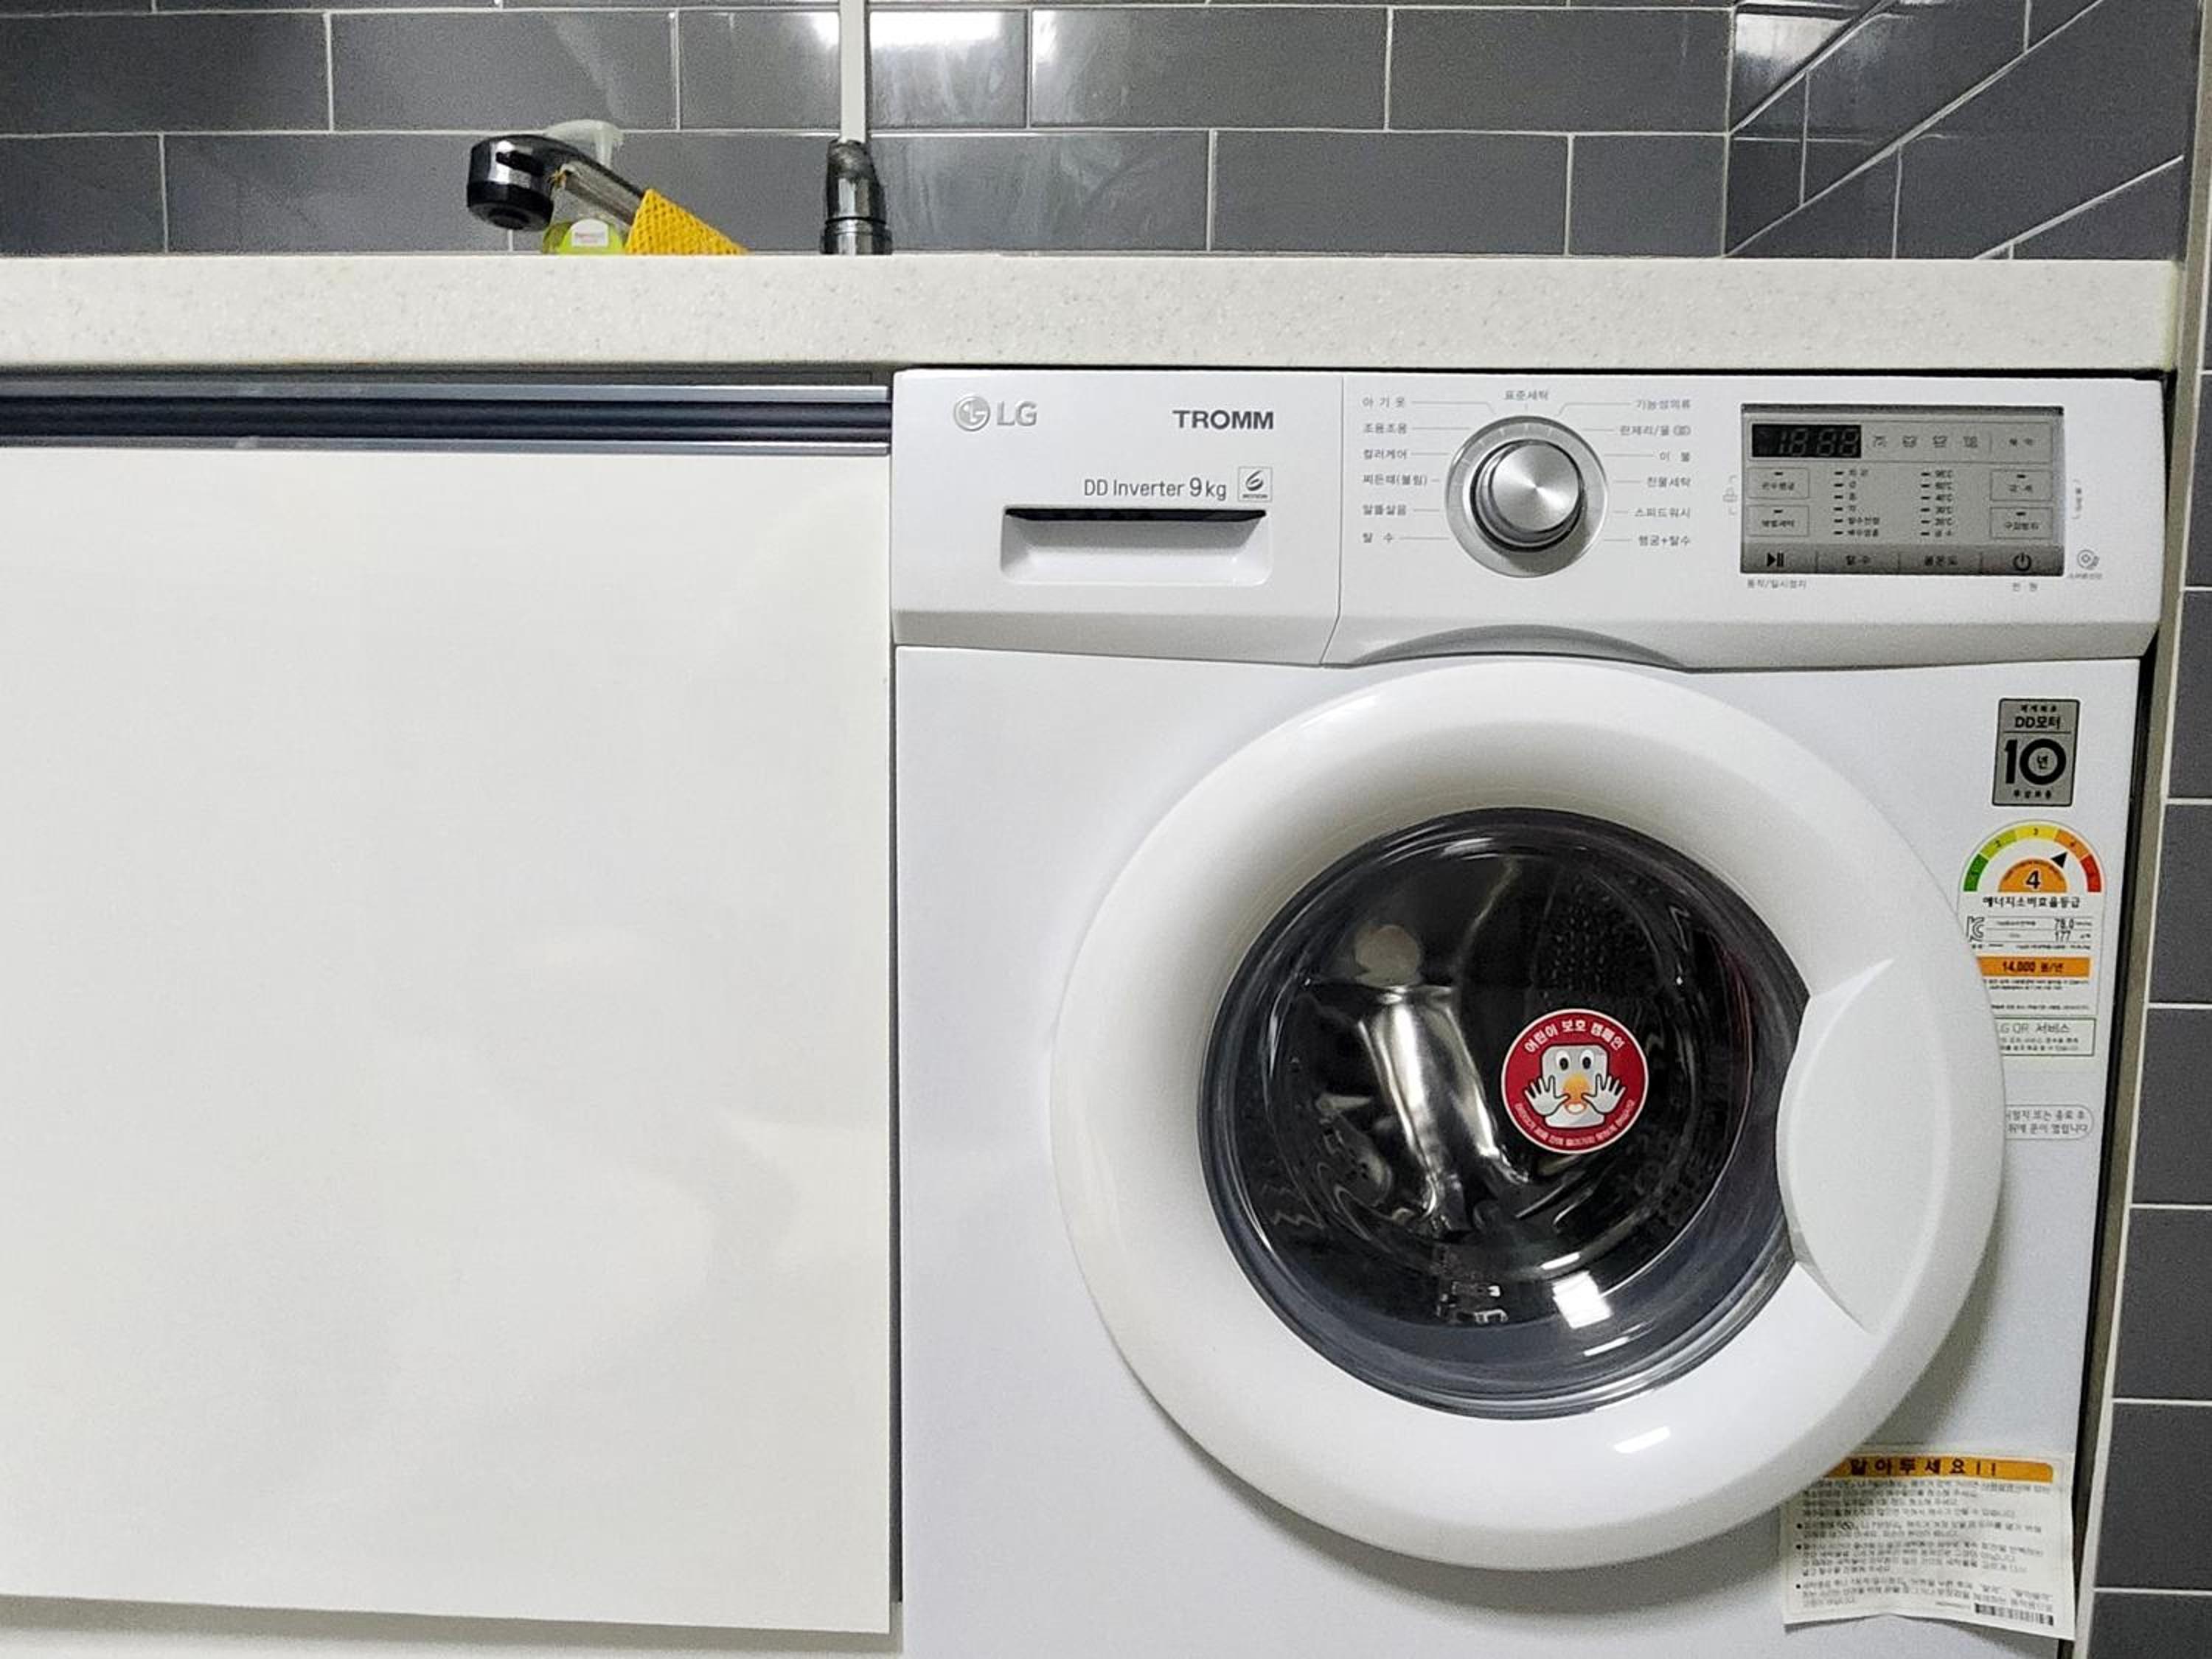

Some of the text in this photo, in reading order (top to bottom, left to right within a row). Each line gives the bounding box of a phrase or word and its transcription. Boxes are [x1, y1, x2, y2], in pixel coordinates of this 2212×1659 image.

[995, 400, 1037, 427] LG
[1172, 409, 1275, 431] TROMM
[1084, 479, 1107, 496] DD
[1113, 479, 1184, 497] Inverter
[2014, 715, 2061, 730] DD모터
[2003, 738, 2067, 785] 10
[2025, 869, 2042, 889] 4
[1524, 1019, 1625, 1053] 어린이 보호 캠페인
[2036, 1022, 2070, 1034] 서비스
